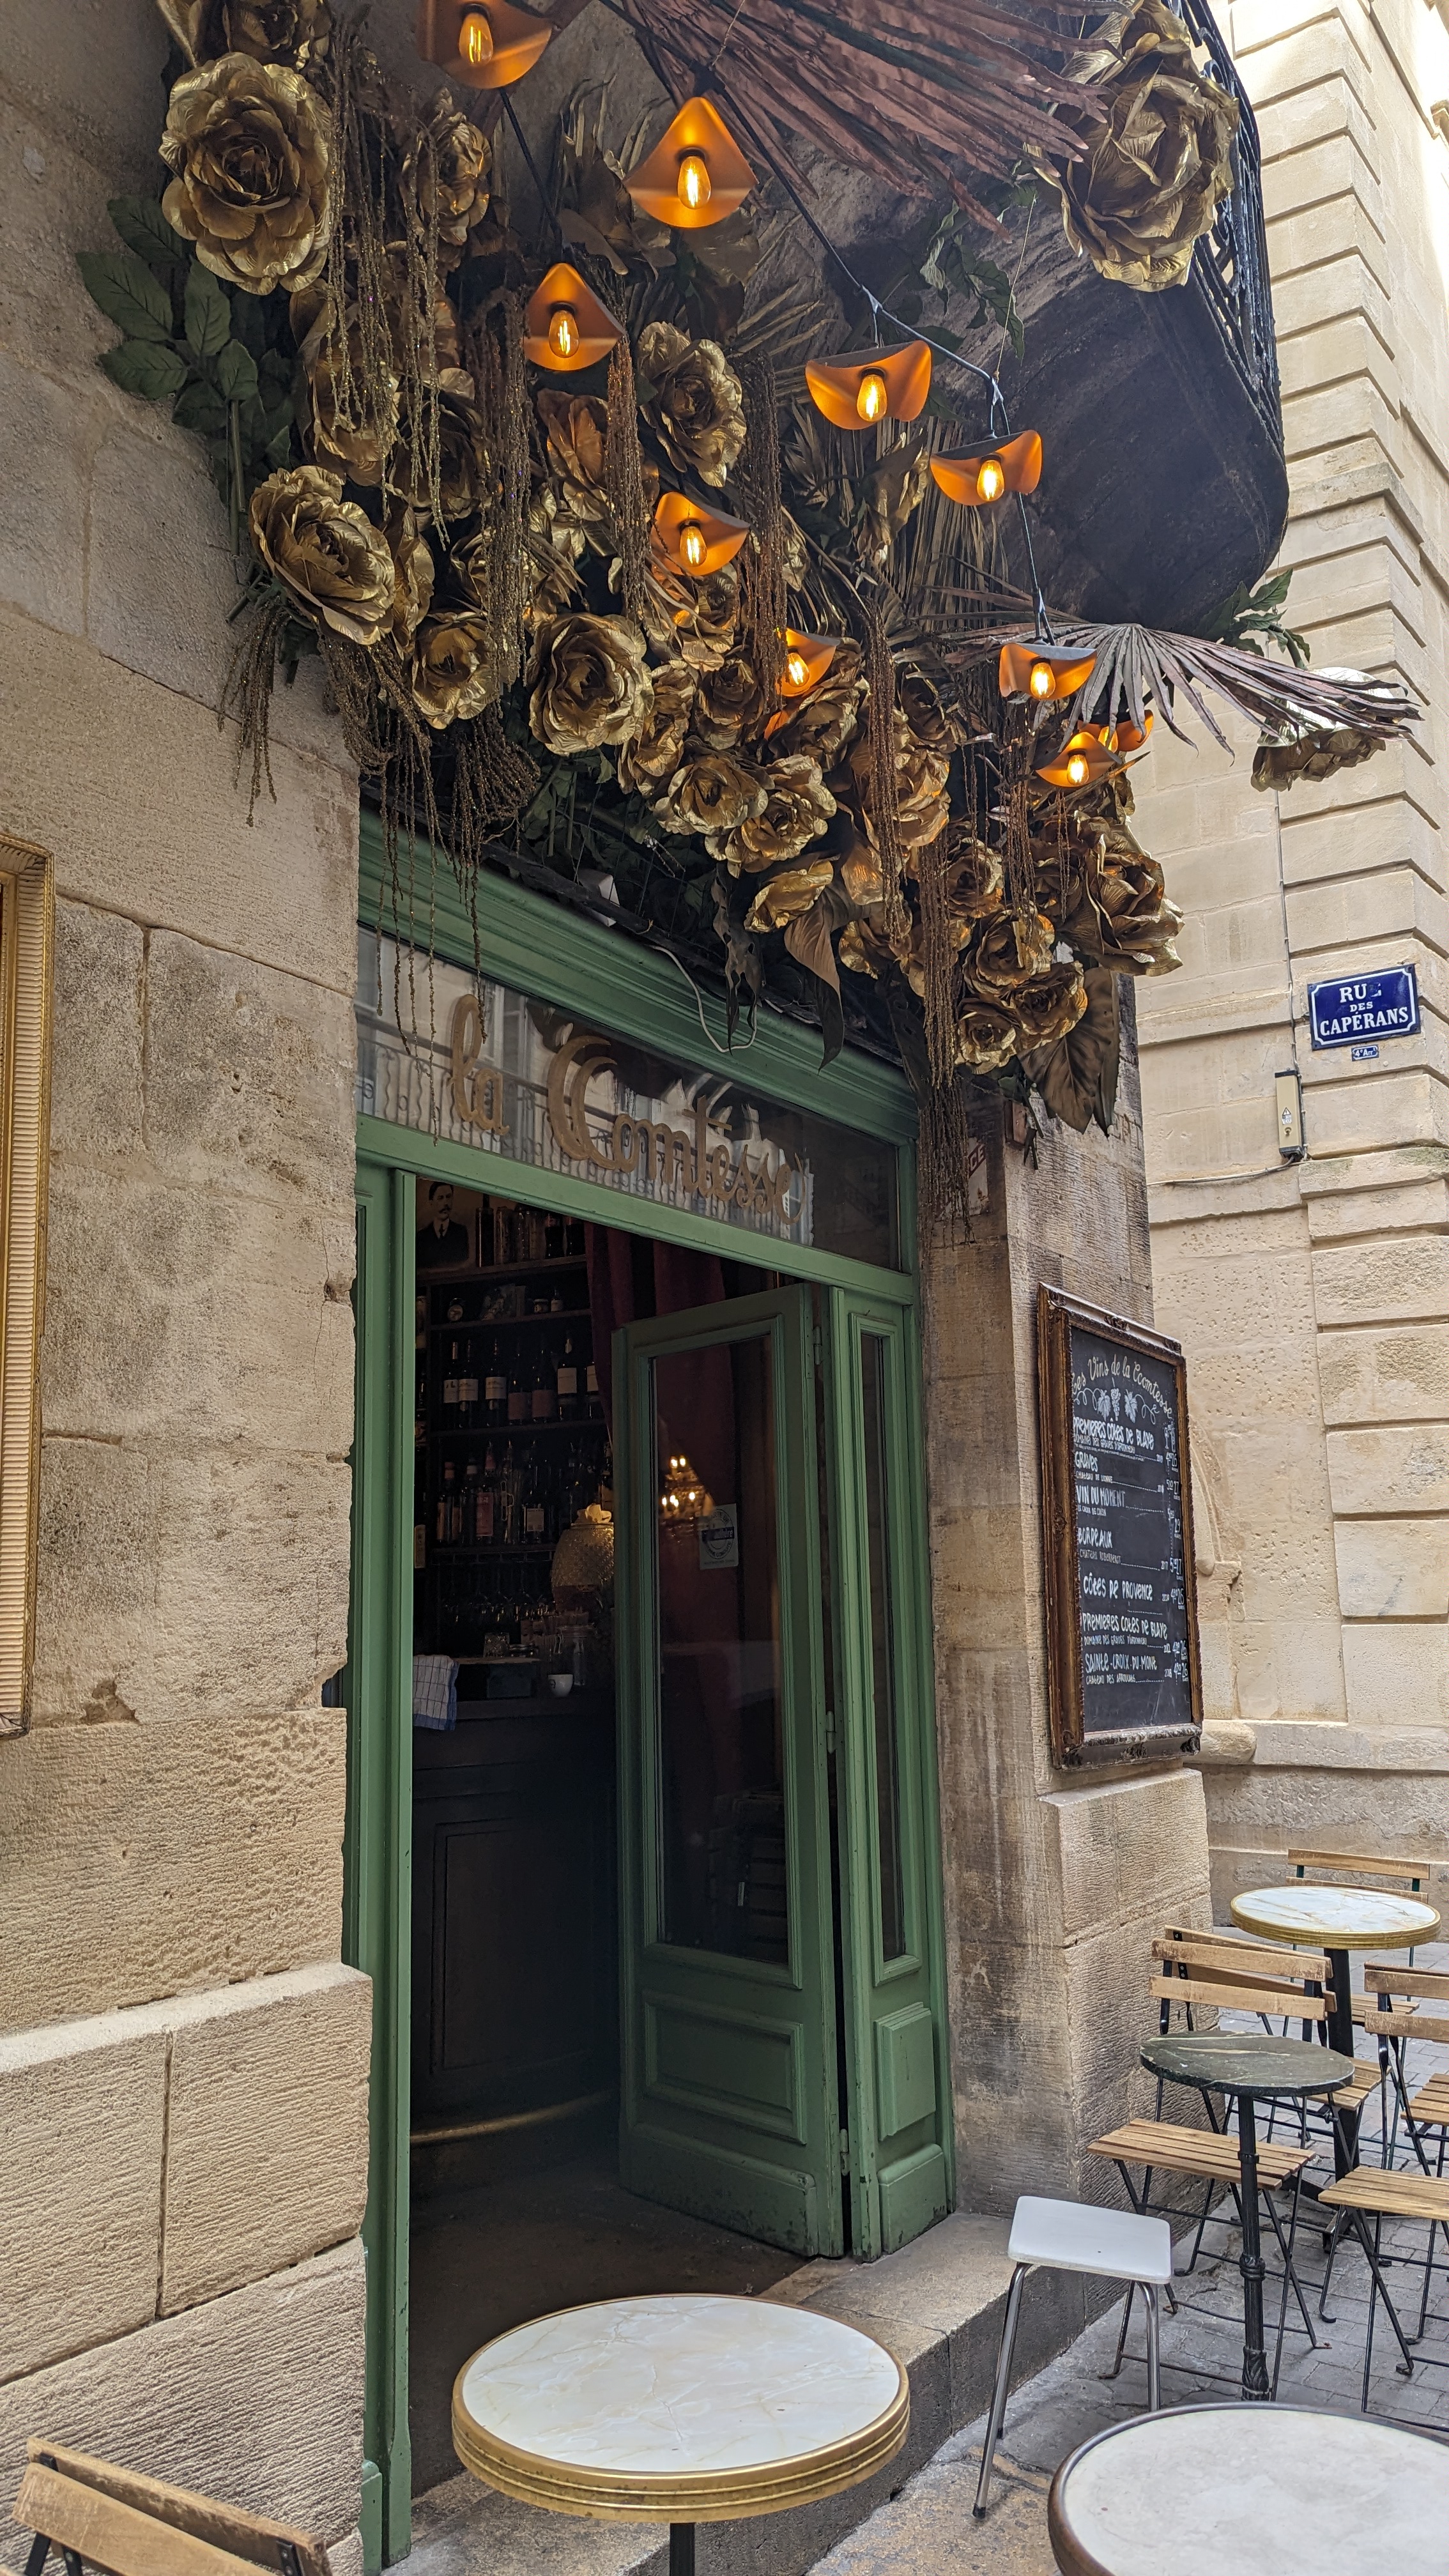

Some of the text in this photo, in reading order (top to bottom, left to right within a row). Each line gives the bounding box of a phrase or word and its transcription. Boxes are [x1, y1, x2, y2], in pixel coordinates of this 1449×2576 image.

[1349, 1001, 1373, 1013] DES
[1320, 1007, 1409, 1036] CAPÉRANS
[1087, 1356, 1109, 1381] Vins
[1111, 1354, 1120, 1376] de
[1123, 1356, 1130, 1379] la
[1076, 1485, 1126, 1508] VIN DU MOMENT
